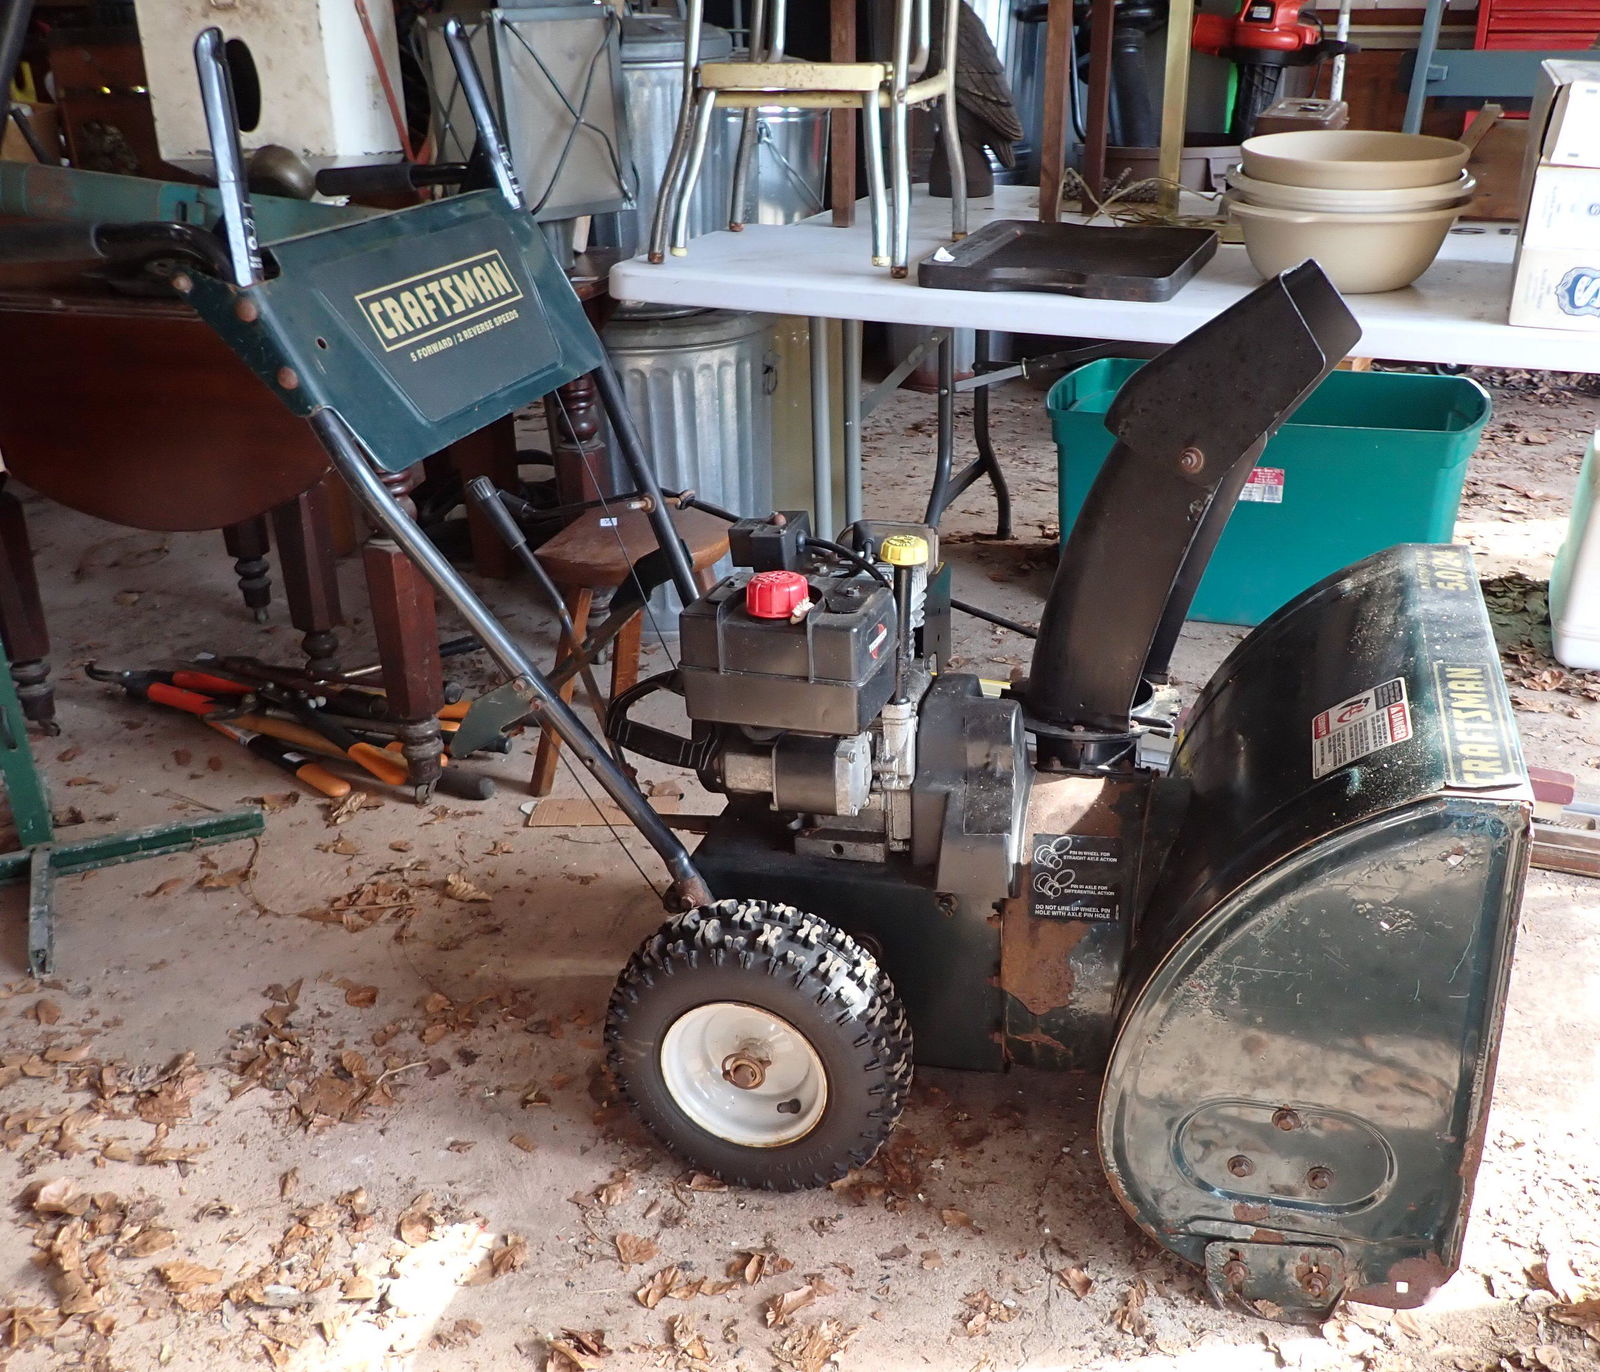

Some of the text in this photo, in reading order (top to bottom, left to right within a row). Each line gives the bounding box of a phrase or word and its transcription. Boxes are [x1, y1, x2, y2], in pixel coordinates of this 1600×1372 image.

[369, 260, 513, 339] CRAFTSMAN
[409, 351, 418, 362] 5
[416, 336, 454, 360] FORWARD
[456, 332, 464, 342] 2
[462, 319, 495, 340] REVERSE
[493, 309, 519, 327] SPEEDS
[1391, 711, 1407, 740] DANGER
[1445, 667, 1504, 784] CRAFTSMAN
